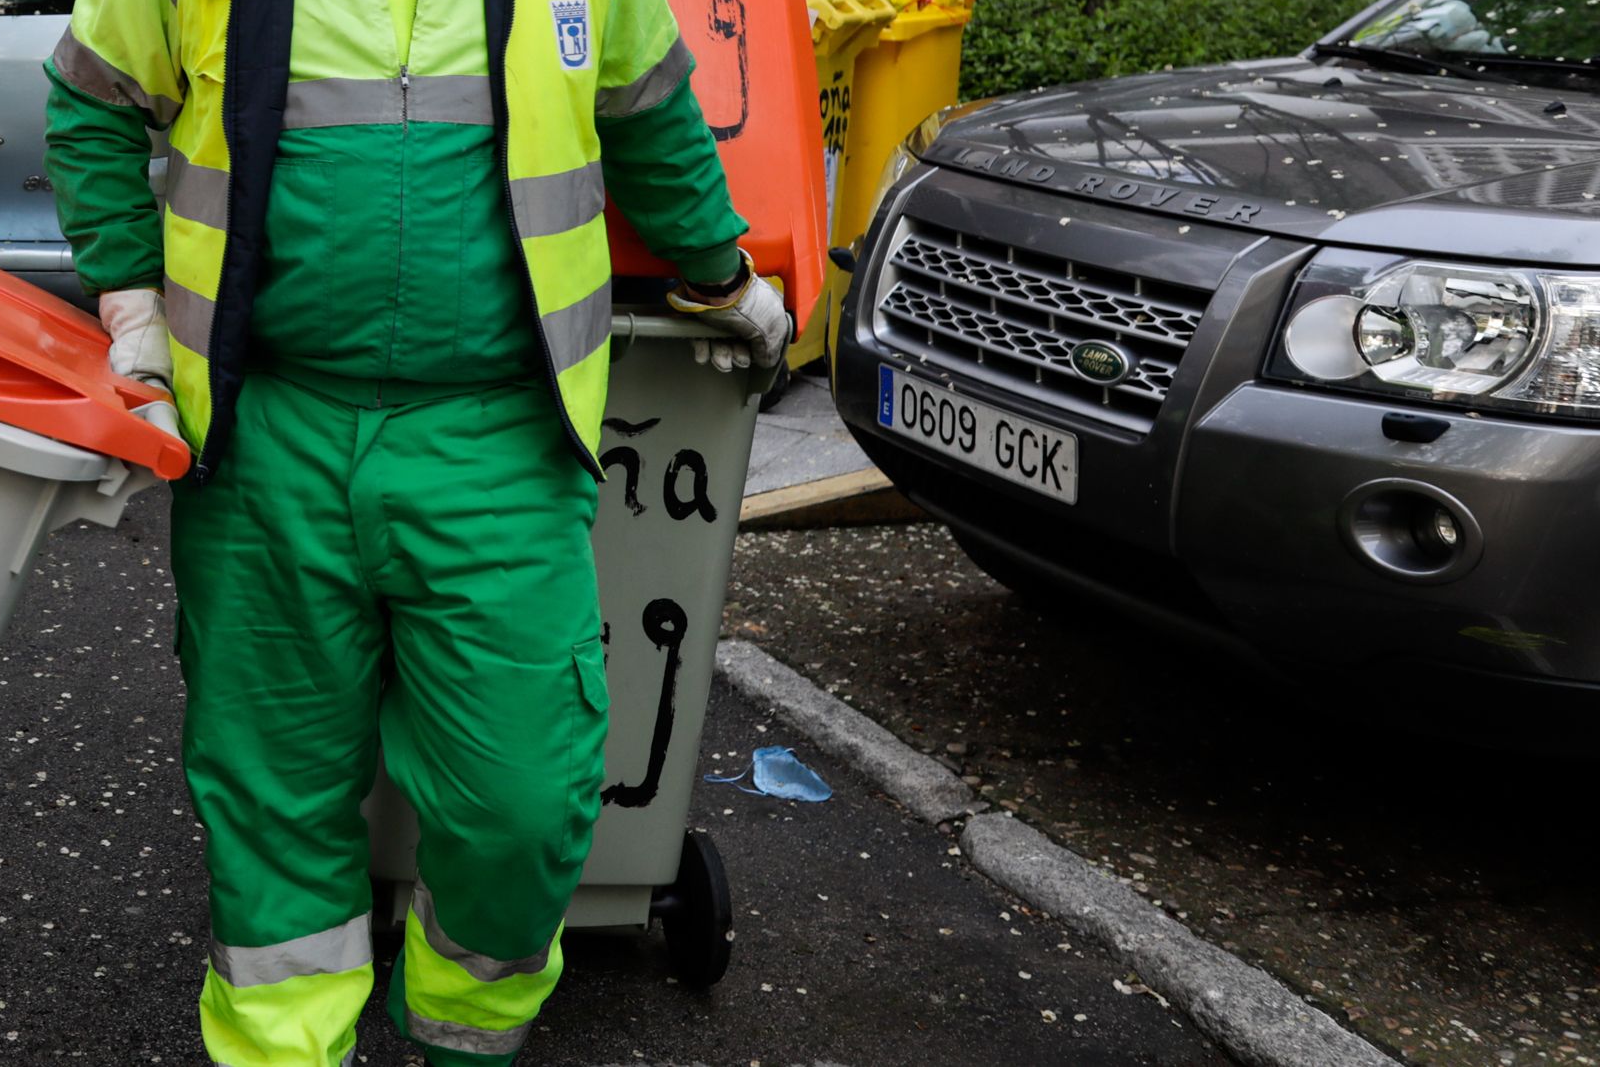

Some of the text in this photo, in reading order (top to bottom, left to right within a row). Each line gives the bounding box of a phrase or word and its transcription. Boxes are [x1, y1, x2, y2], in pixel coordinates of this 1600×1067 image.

[952, 147, 1262, 224] LAND ROVER
[1082, 348, 1109, 362] LAND
[1083, 358, 1114, 375] ROVER
[600, 417, 718, 524] ña
[901, 383, 977, 454] 0609
[995, 419, 1063, 492] GCK
